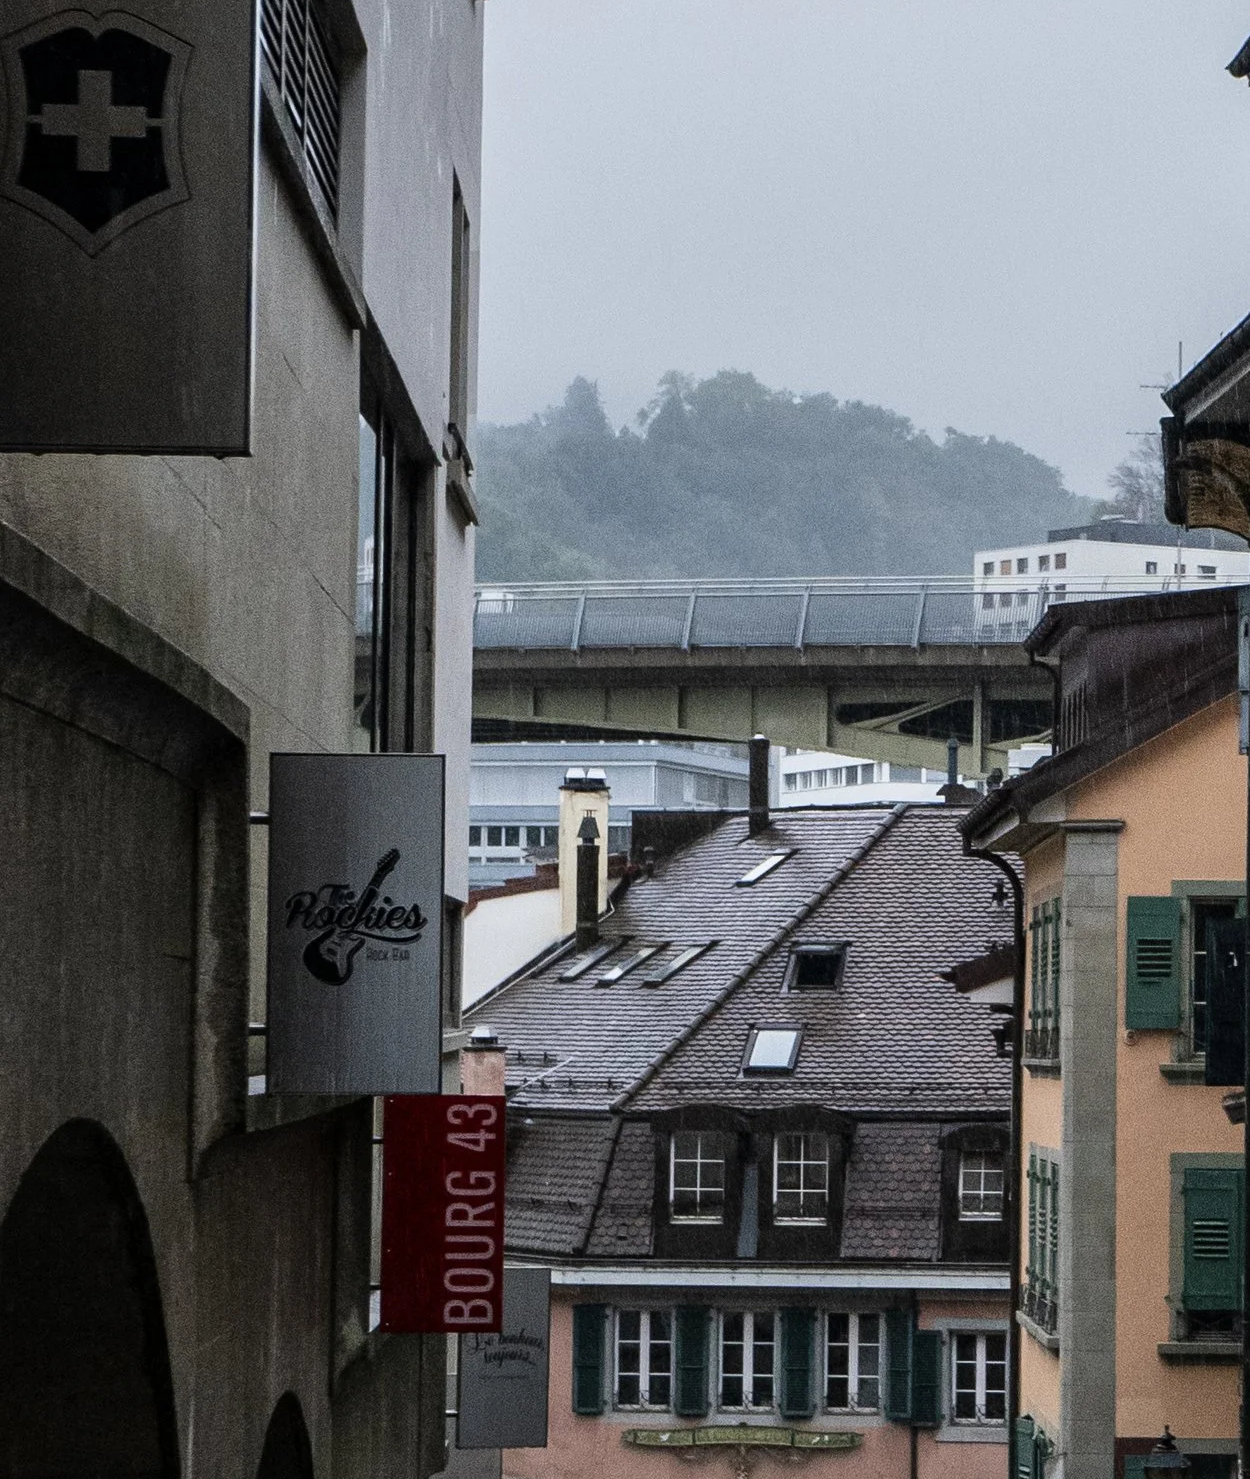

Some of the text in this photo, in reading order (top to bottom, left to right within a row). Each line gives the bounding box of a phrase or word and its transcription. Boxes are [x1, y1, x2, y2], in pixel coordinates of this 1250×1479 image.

[285, 888, 428, 931] Rockies
[442, 1102, 498, 1325] BOURG 43
